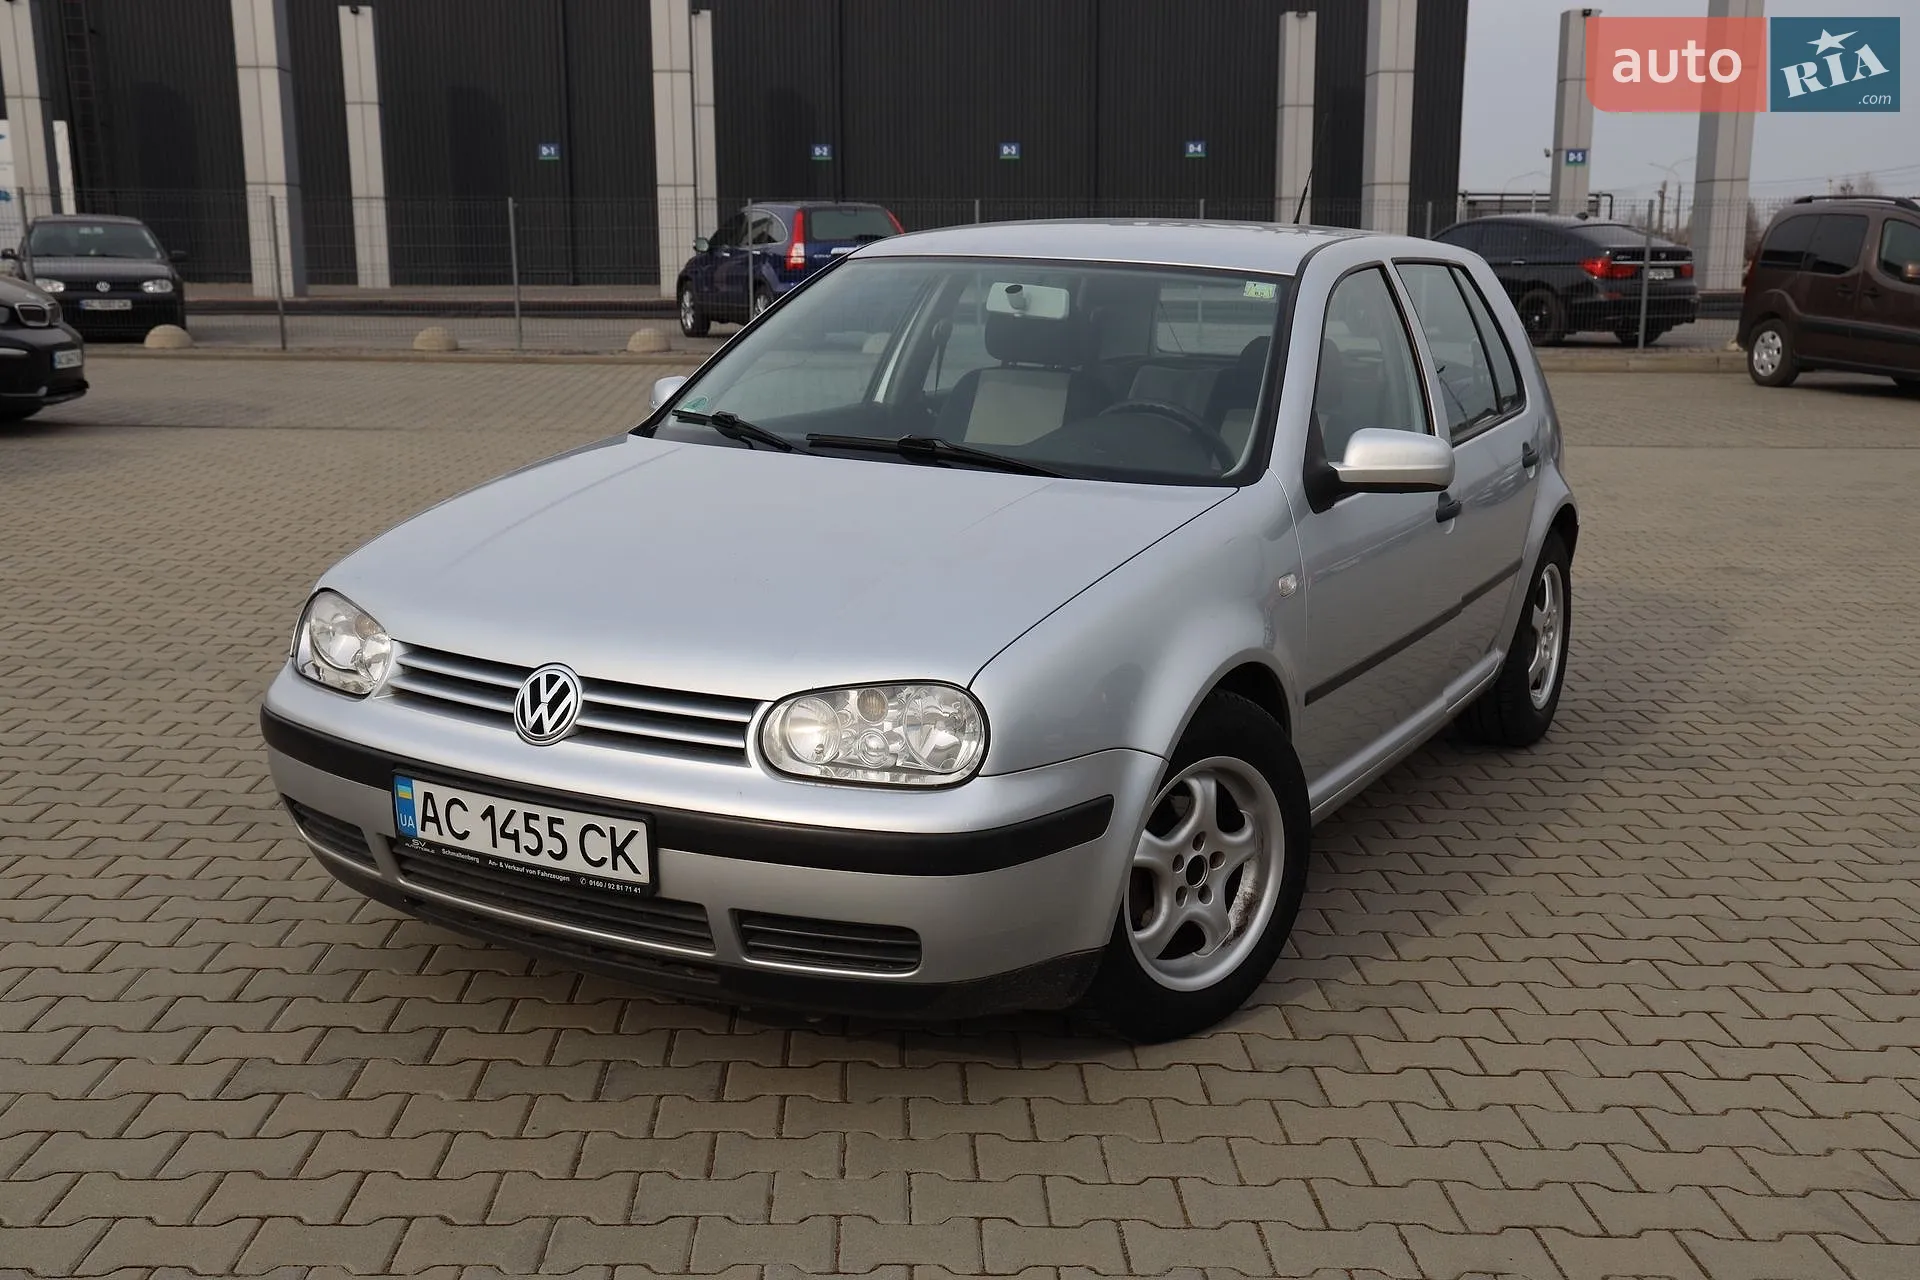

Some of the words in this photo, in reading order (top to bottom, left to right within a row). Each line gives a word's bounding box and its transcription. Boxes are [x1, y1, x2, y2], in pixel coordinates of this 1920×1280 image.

[400, 813, 415, 829] UA
[420, 791, 471, 841] AC
[480, 804, 568, 861] 1455
[578, 823, 642, 875] CK
[504, 862, 525, 873] Verkauf
[525, 868, 537, 876] von
[537, 869, 570, 882] Fahrzeugen
